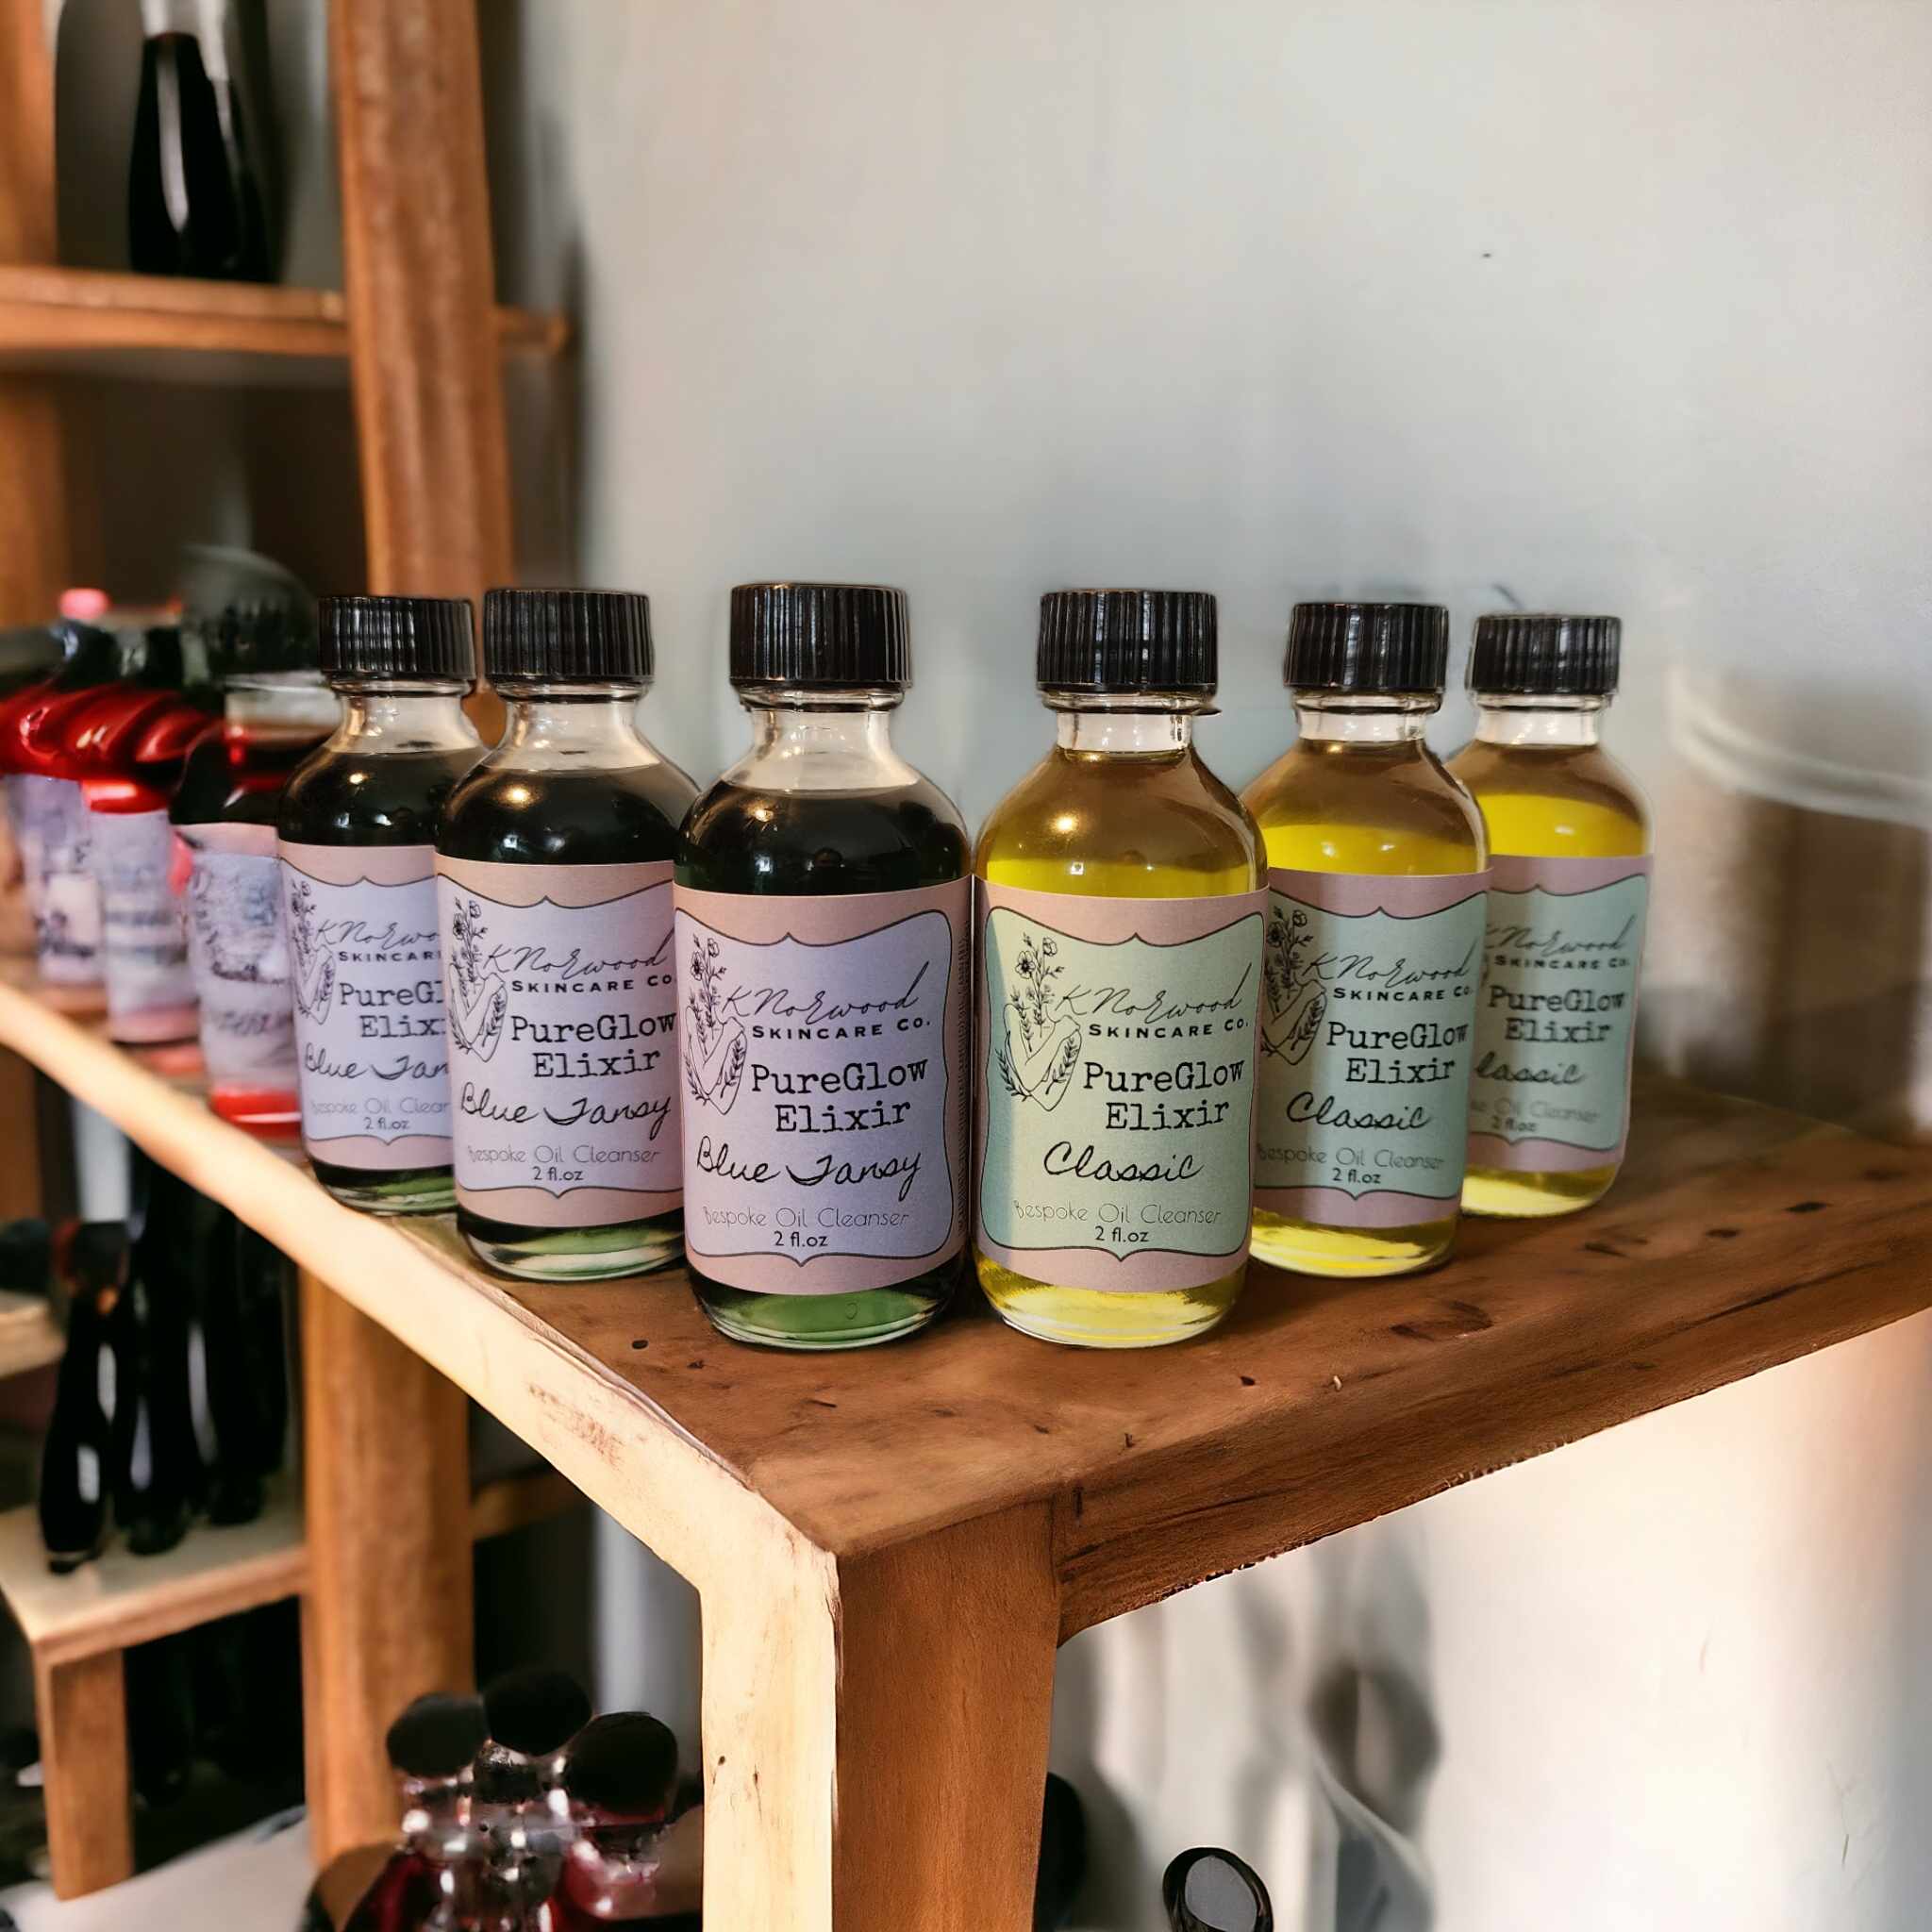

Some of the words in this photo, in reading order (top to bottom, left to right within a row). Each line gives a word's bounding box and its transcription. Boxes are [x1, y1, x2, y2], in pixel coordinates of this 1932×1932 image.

[1494, 955, 1600, 970] SKINCARE
[339, 980, 443, 1007] PureG
[511, 979, 634, 993] SKINCARE
[1333, 988, 1445, 1002] SKINCARE
[1488, 985, 1624, 1012] PureGlow
[359, 1014, 446, 1038] Elix
[510, 1012, 676, 1042] PureGlow
[752, 1024, 883, 1039] SKINCARE
[896, 1018, 931, 1030] Co.
[1089, 1024, 1213, 1038] SKINCARE
[1224, 1018, 1249, 1031] Co.
[1326, 1021, 1469, 1050] PureGlow
[1505, 1017, 1610, 1042] Elixir
[305, 1041, 369, 1079] Blue
[371, 1055, 449, 1080] Tan
[533, 1049, 660, 1077] Elixir
[1345, 1058, 1456, 1085] Elixir
[1475, 1051, 1586, 1085] lassic
[751, 1058, 928, 1094] PureGlow
[1083, 1060, 1245, 1092] PureGlow
[364, 1117, 374, 1129] 2
[461, 1082, 539, 1123] Blue
[543, 1095, 671, 1141] Tansy
[775, 1100, 911, 1133] Elixir
[1105, 1099, 1230, 1131] Elixir
[1287, 1091, 1432, 1130] Classic
[534, 1144, 564, 1163] Oil
[573, 1143, 661, 1164] Cleanser
[1043, 1141, 1206, 1182] Classic
[1336, 1147, 1364, 1167] Oil
[1374, 1149, 1445, 1170] Cleanser
[532, 1166, 541, 1180] 2
[547, 1167, 584, 1181] fl.oz
[696, 1136, 780, 1183] Blue
[785, 1152, 922, 1202] Tansy
[1333, 1168, 1342, 1181] 2
[1347, 1170, 1381, 1184] fl.oz
[775, 1208, 808, 1227] Oil
[818, 1208, 910, 1227] Cleanser
[1098, 1203, 1131, 1224] Oil
[1140, 1204, 1223, 1224] Cleanser
[774, 1230, 785, 1246] 2
[791, 1231, 829, 1247] fl.oz
[1095, 1226, 1106, 1241] 2
[1111, 1227, 1150, 1243] fl.oz
